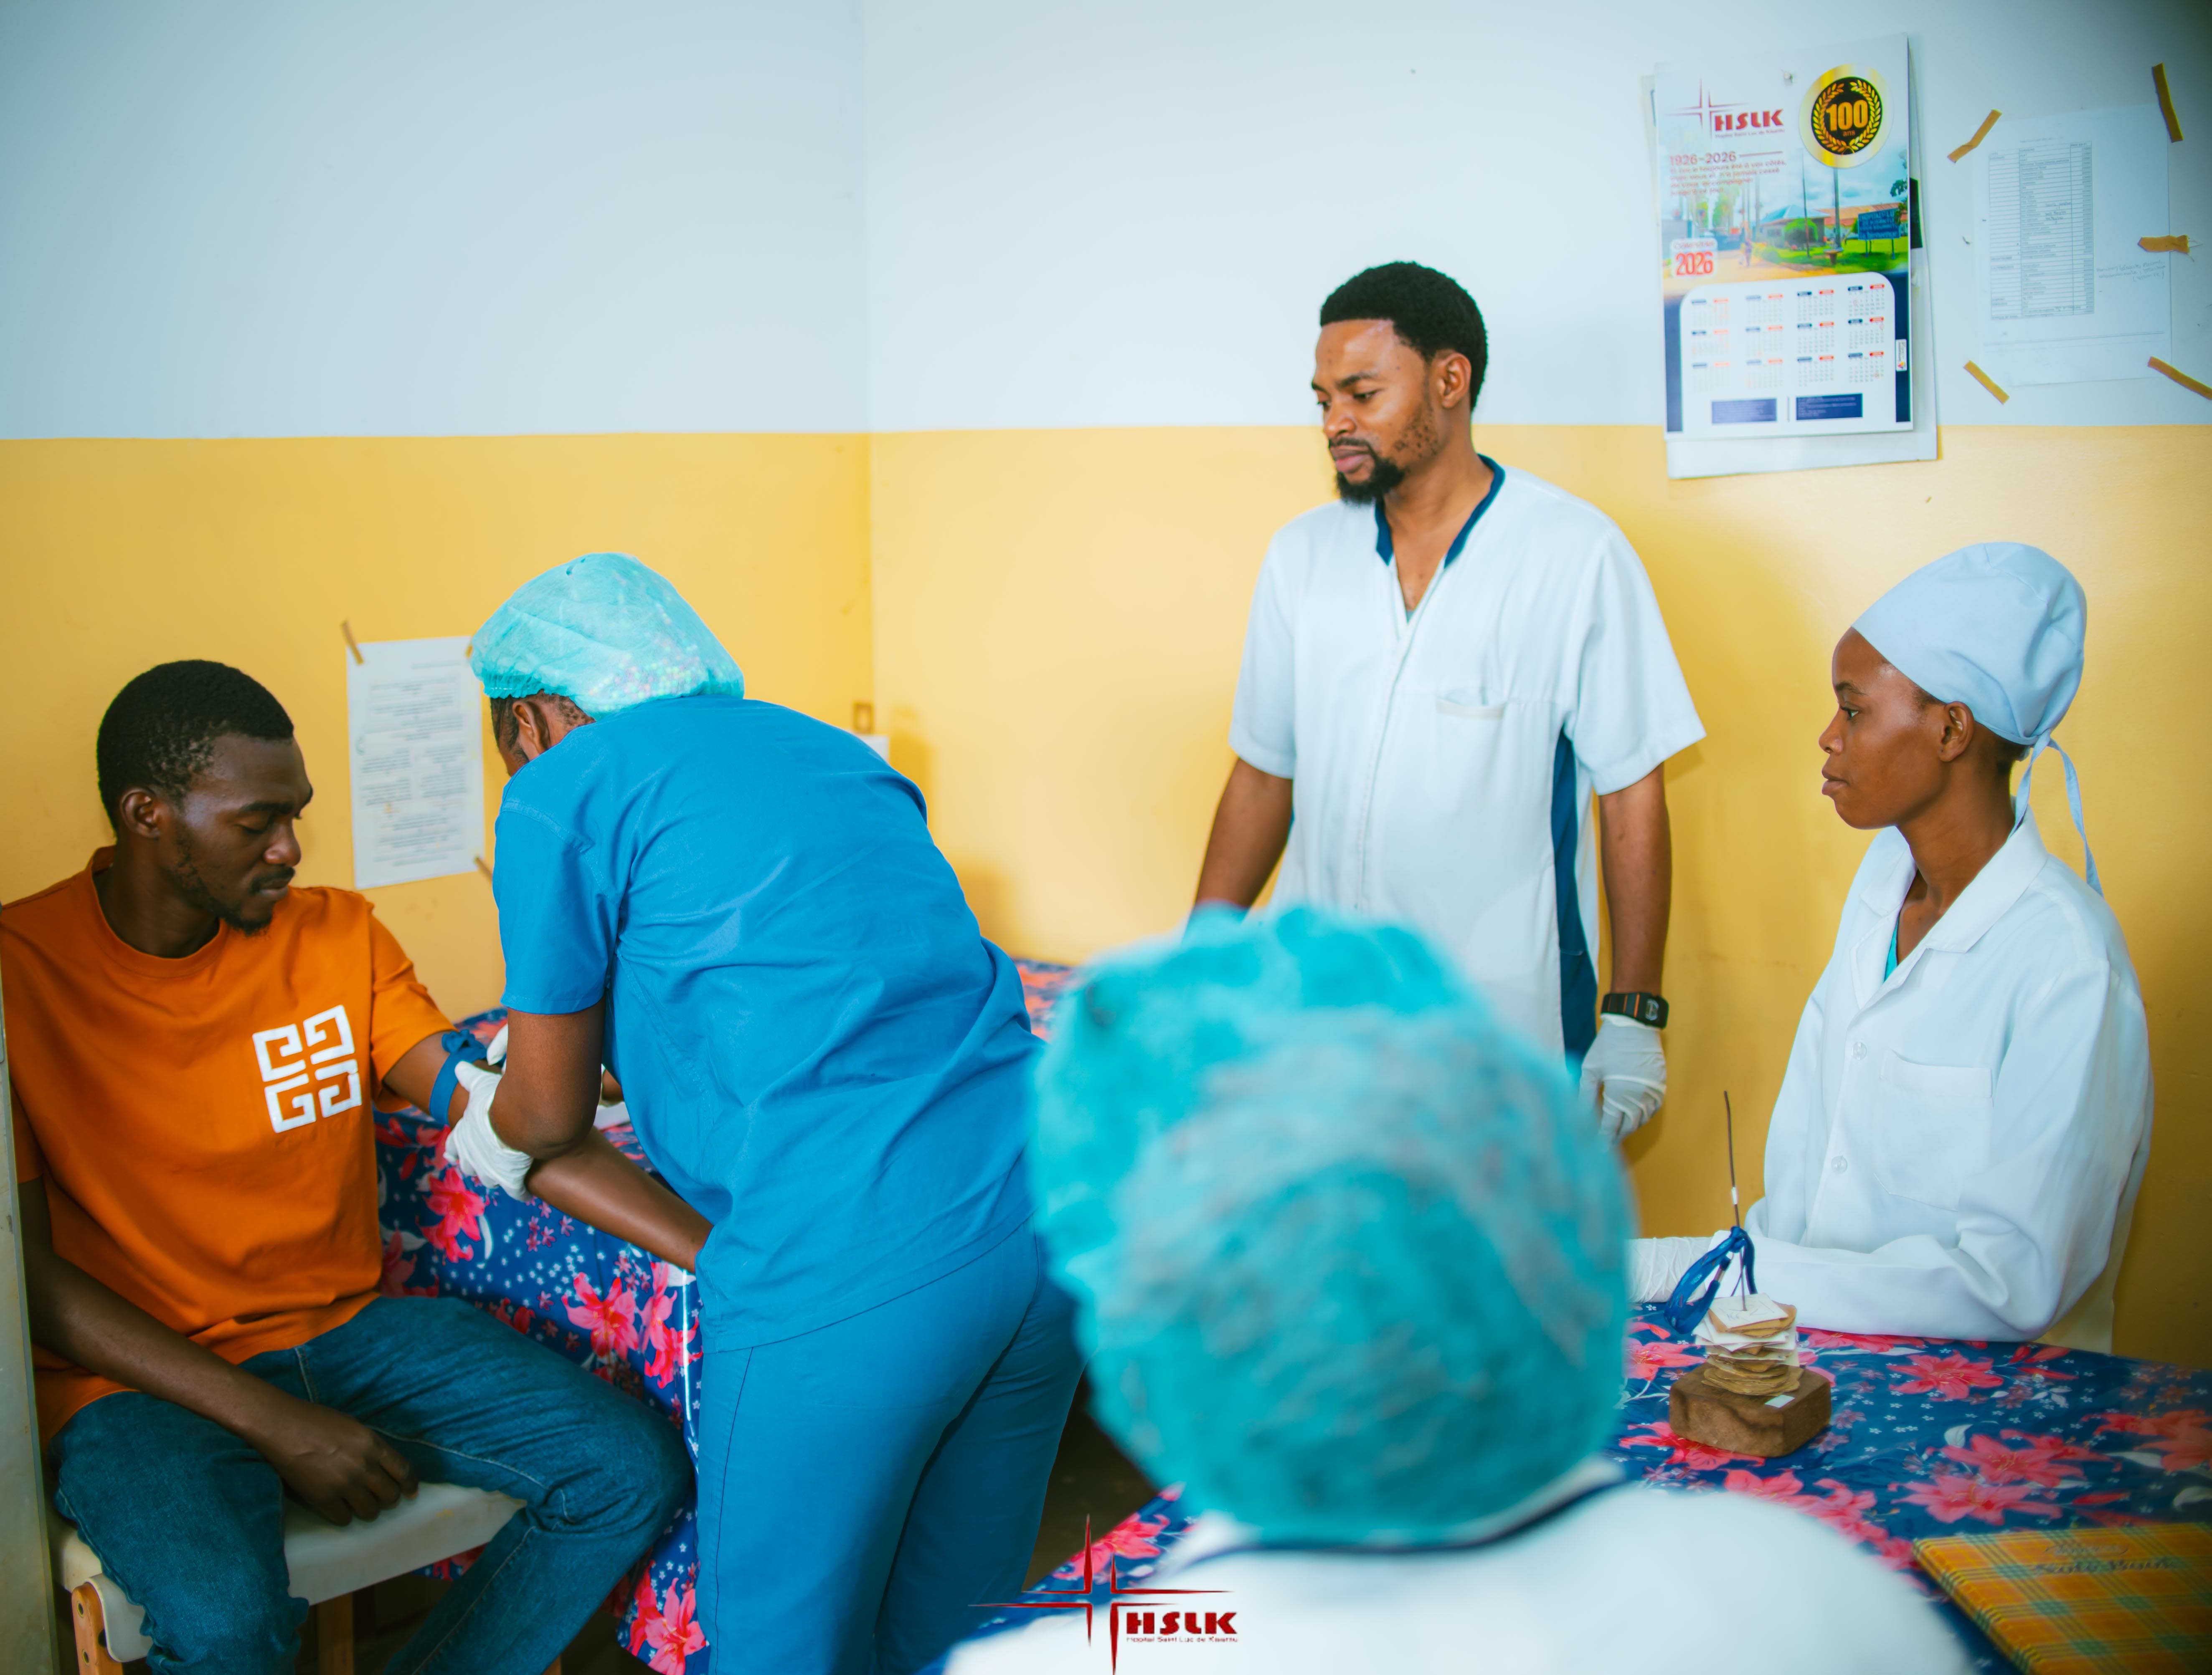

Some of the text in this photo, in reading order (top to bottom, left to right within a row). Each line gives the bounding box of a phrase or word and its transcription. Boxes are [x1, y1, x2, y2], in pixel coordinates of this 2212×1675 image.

[1715, 109, 1784, 131] HSLK
[1826, 99, 1868, 131] 100
[1676, 251, 1713, 276] 2026
